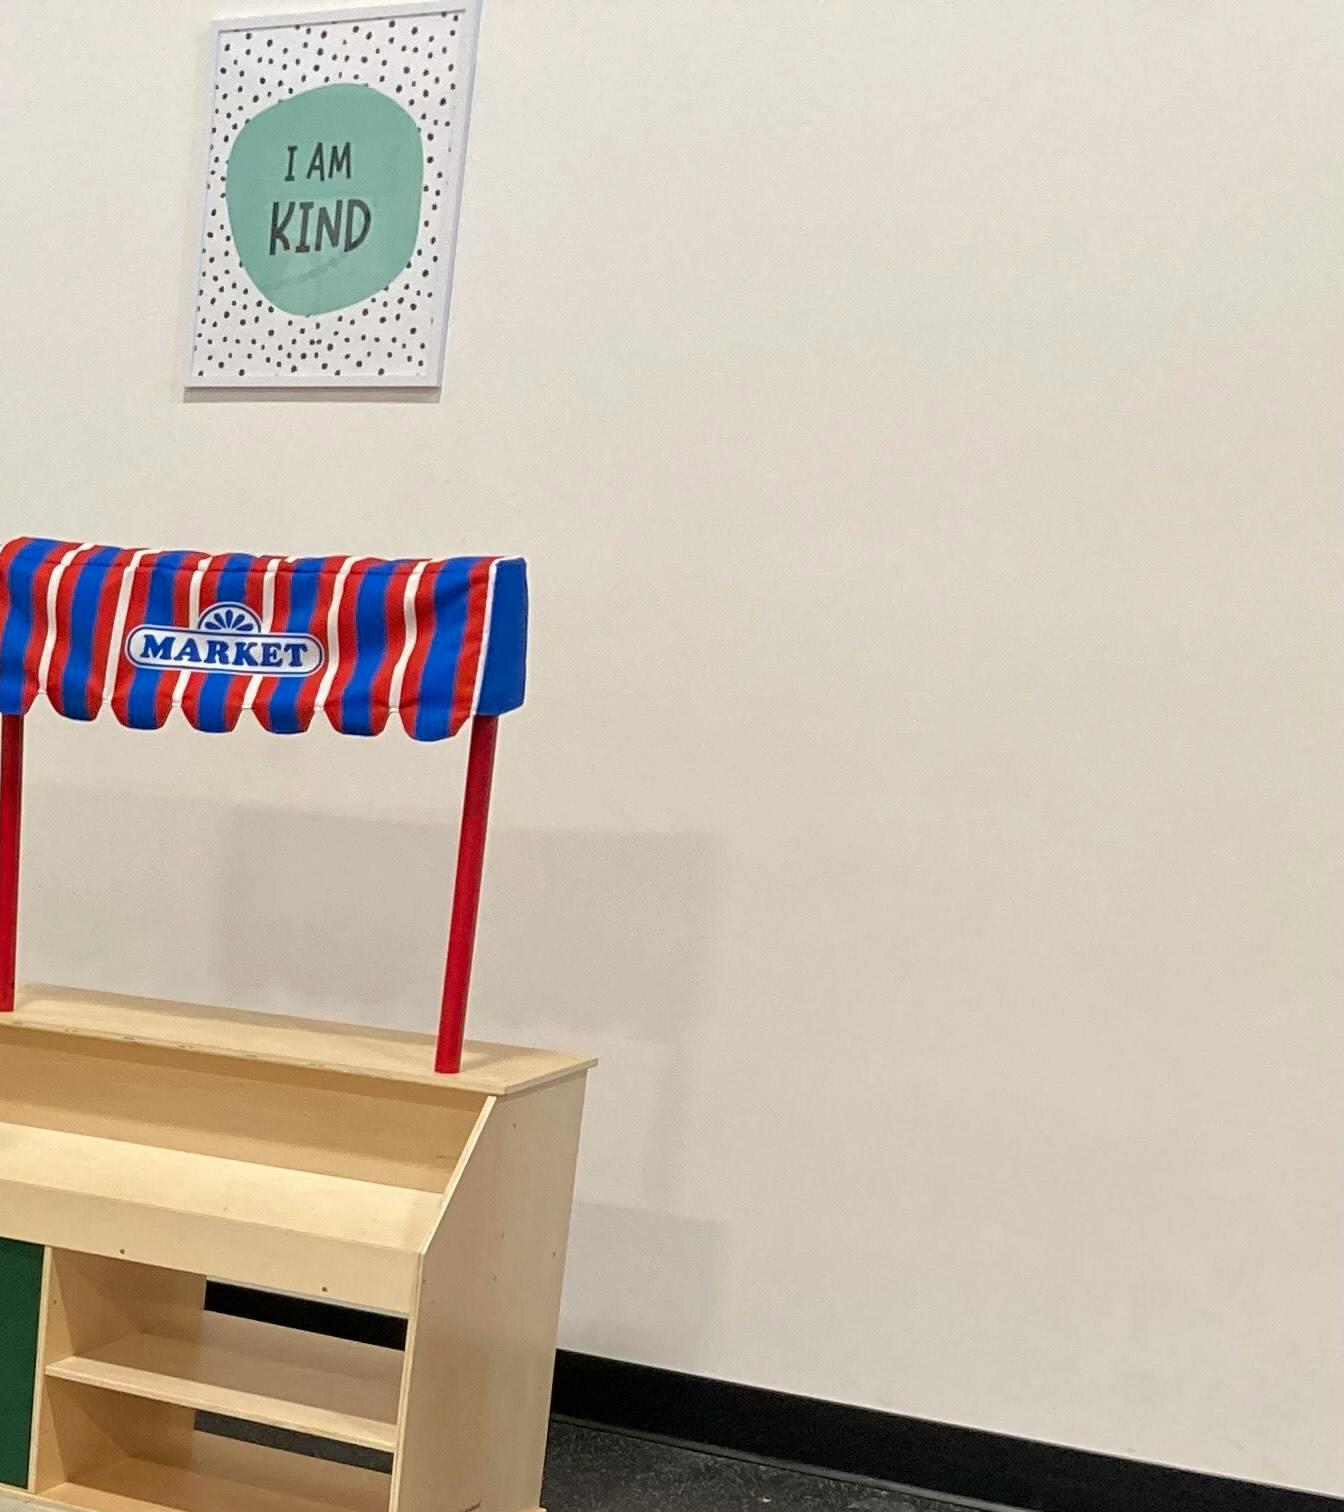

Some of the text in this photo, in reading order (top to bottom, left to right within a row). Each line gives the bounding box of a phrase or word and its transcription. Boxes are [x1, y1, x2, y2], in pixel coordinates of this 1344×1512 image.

[284, 142, 351, 182] I AM
[269, 199, 372, 256] KIND
[139, 633, 309, 668] MARKET
